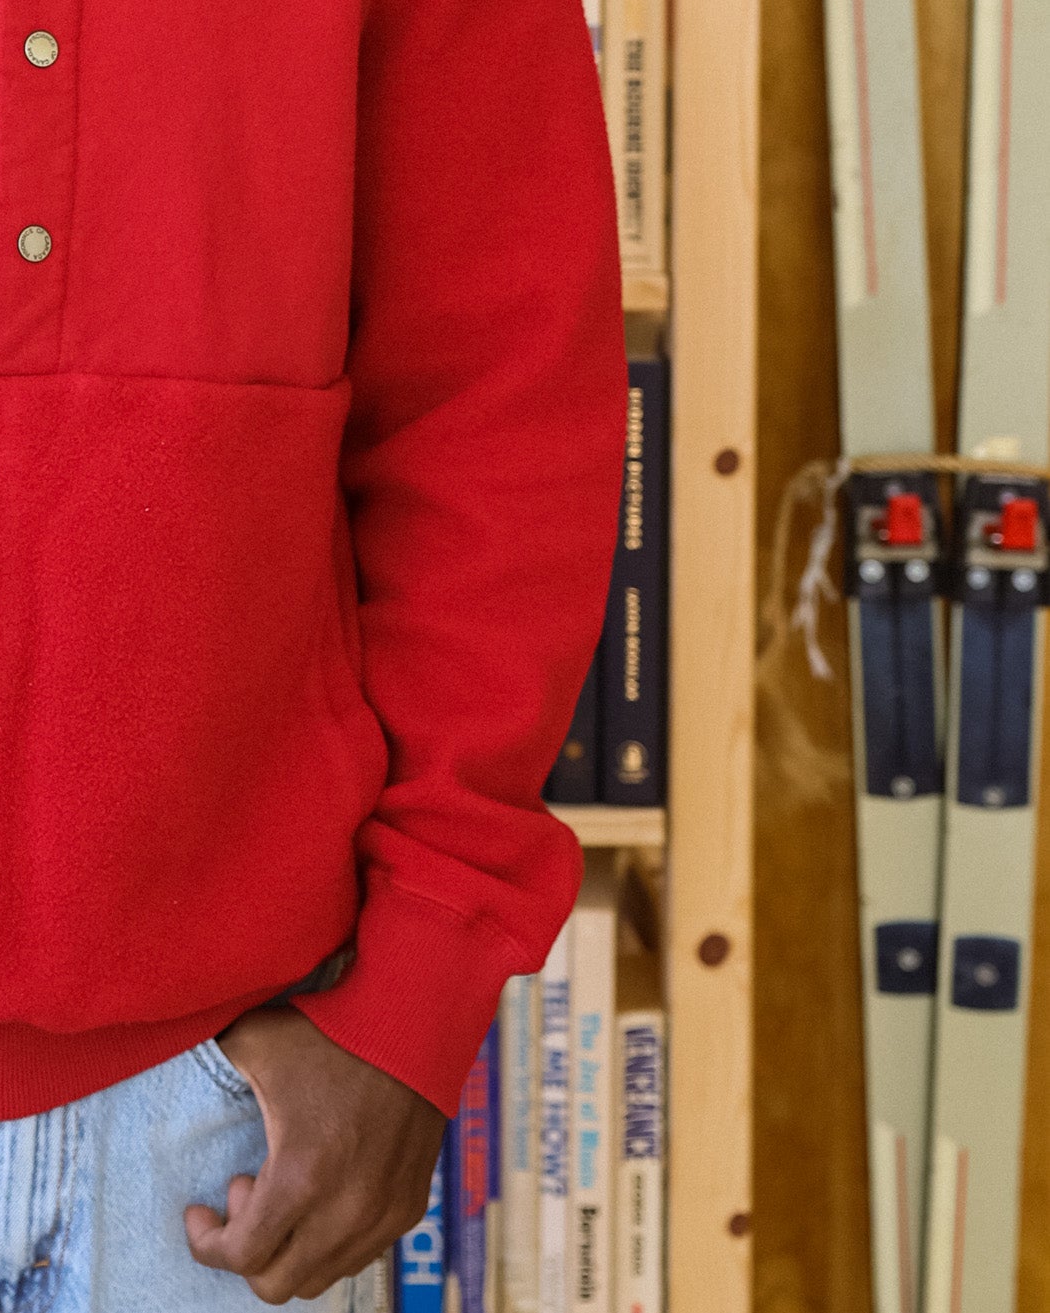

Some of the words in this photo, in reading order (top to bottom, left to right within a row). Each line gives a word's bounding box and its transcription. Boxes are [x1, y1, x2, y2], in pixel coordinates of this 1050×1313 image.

[33, 235, 51, 260] CANADA
[580, 1014, 602, 1050] The
[543, 1049, 568, 1090] ME
[624, 1026, 661, 1160] VENGEANCE
